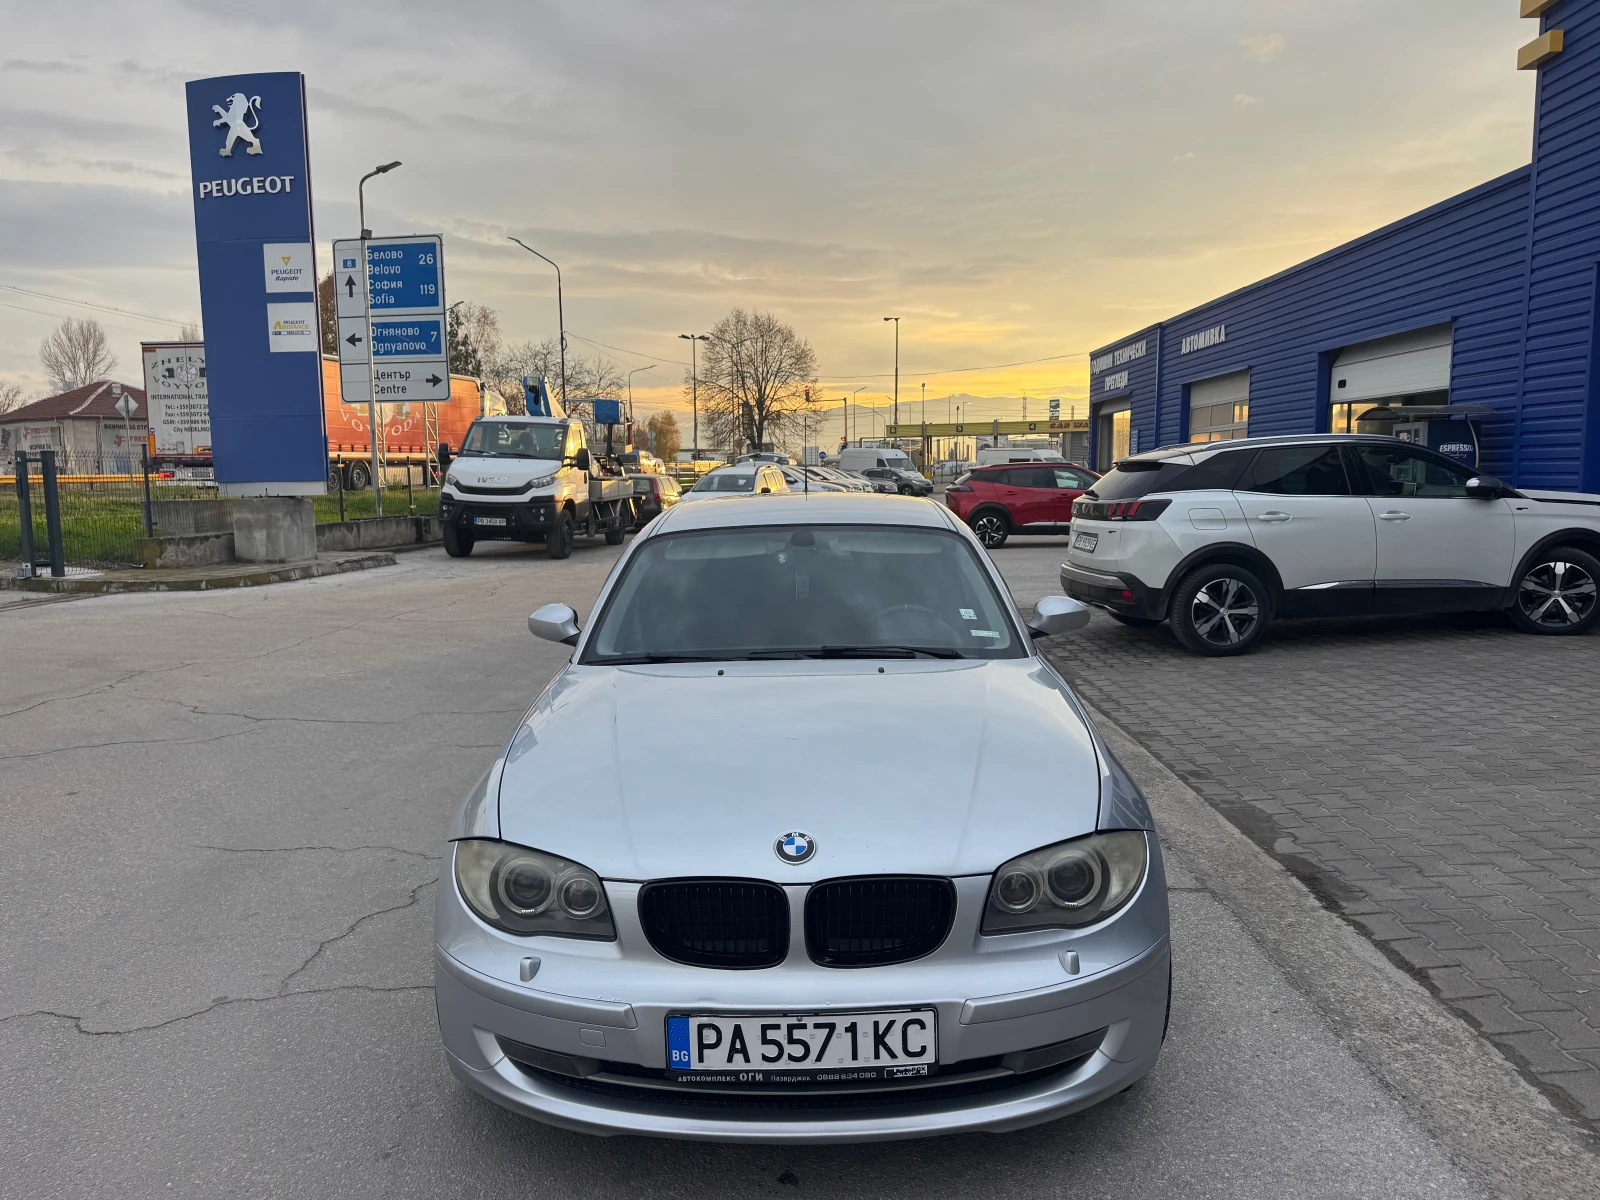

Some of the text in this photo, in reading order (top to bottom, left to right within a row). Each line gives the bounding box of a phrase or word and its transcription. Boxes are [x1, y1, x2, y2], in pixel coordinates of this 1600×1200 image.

[200, 176, 294, 198] PEUGEOT
[367, 250, 434, 264] Белово 26
[367, 264, 401, 275] Belovo
[369, 280, 435, 295] София 119
[369, 294, 395, 304] Sofia
[371, 326, 438, 342] Огняново 7
[1181, 324, 1226, 355] АВТОМИВКА
[372, 341, 426, 354] Ognyanovo
[374, 369, 411, 381] Център
[374, 384, 407, 394] Centre
[780, 832, 812, 842] BMW
[672, 1050, 689, 1062] BG
[739, 1072, 763, 1082] ОГИ
[770, 1075, 811, 1083] Пазарджик
